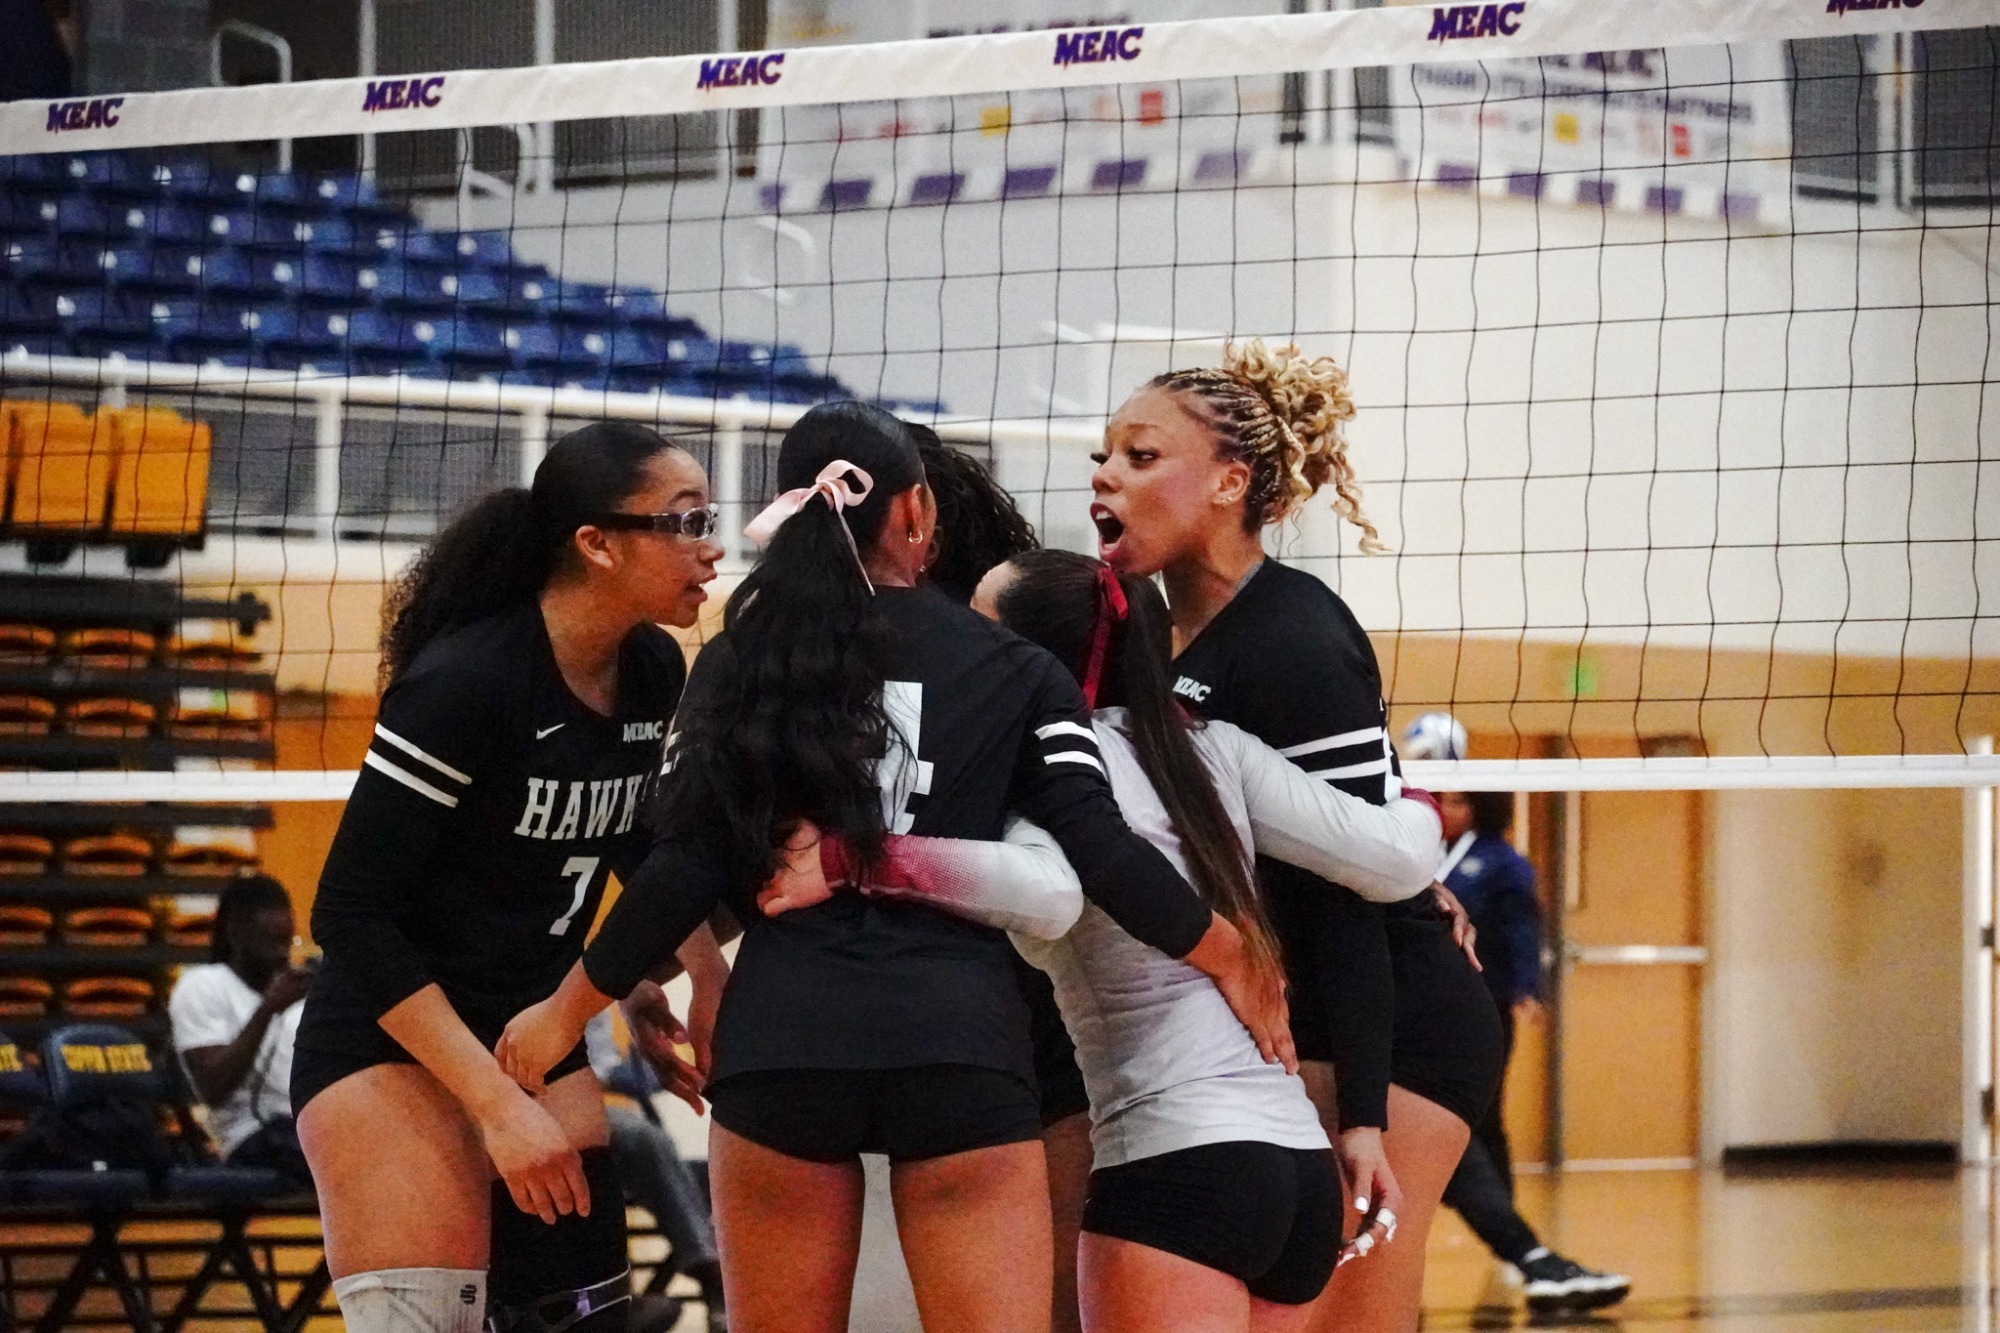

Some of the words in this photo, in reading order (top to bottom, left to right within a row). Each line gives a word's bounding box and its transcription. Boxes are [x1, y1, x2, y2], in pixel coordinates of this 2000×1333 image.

[1428, 2, 1525, 42] MEAC
[1053, 27, 1143, 65] MEAC
[697, 53, 785, 91] MEAC
[363, 76, 444, 112] MEAC
[46, 98, 124, 132] MEAC
[623, 720, 664, 743] MEAC
[513, 775, 653, 841] HAWK
[549, 856, 600, 936] 7
